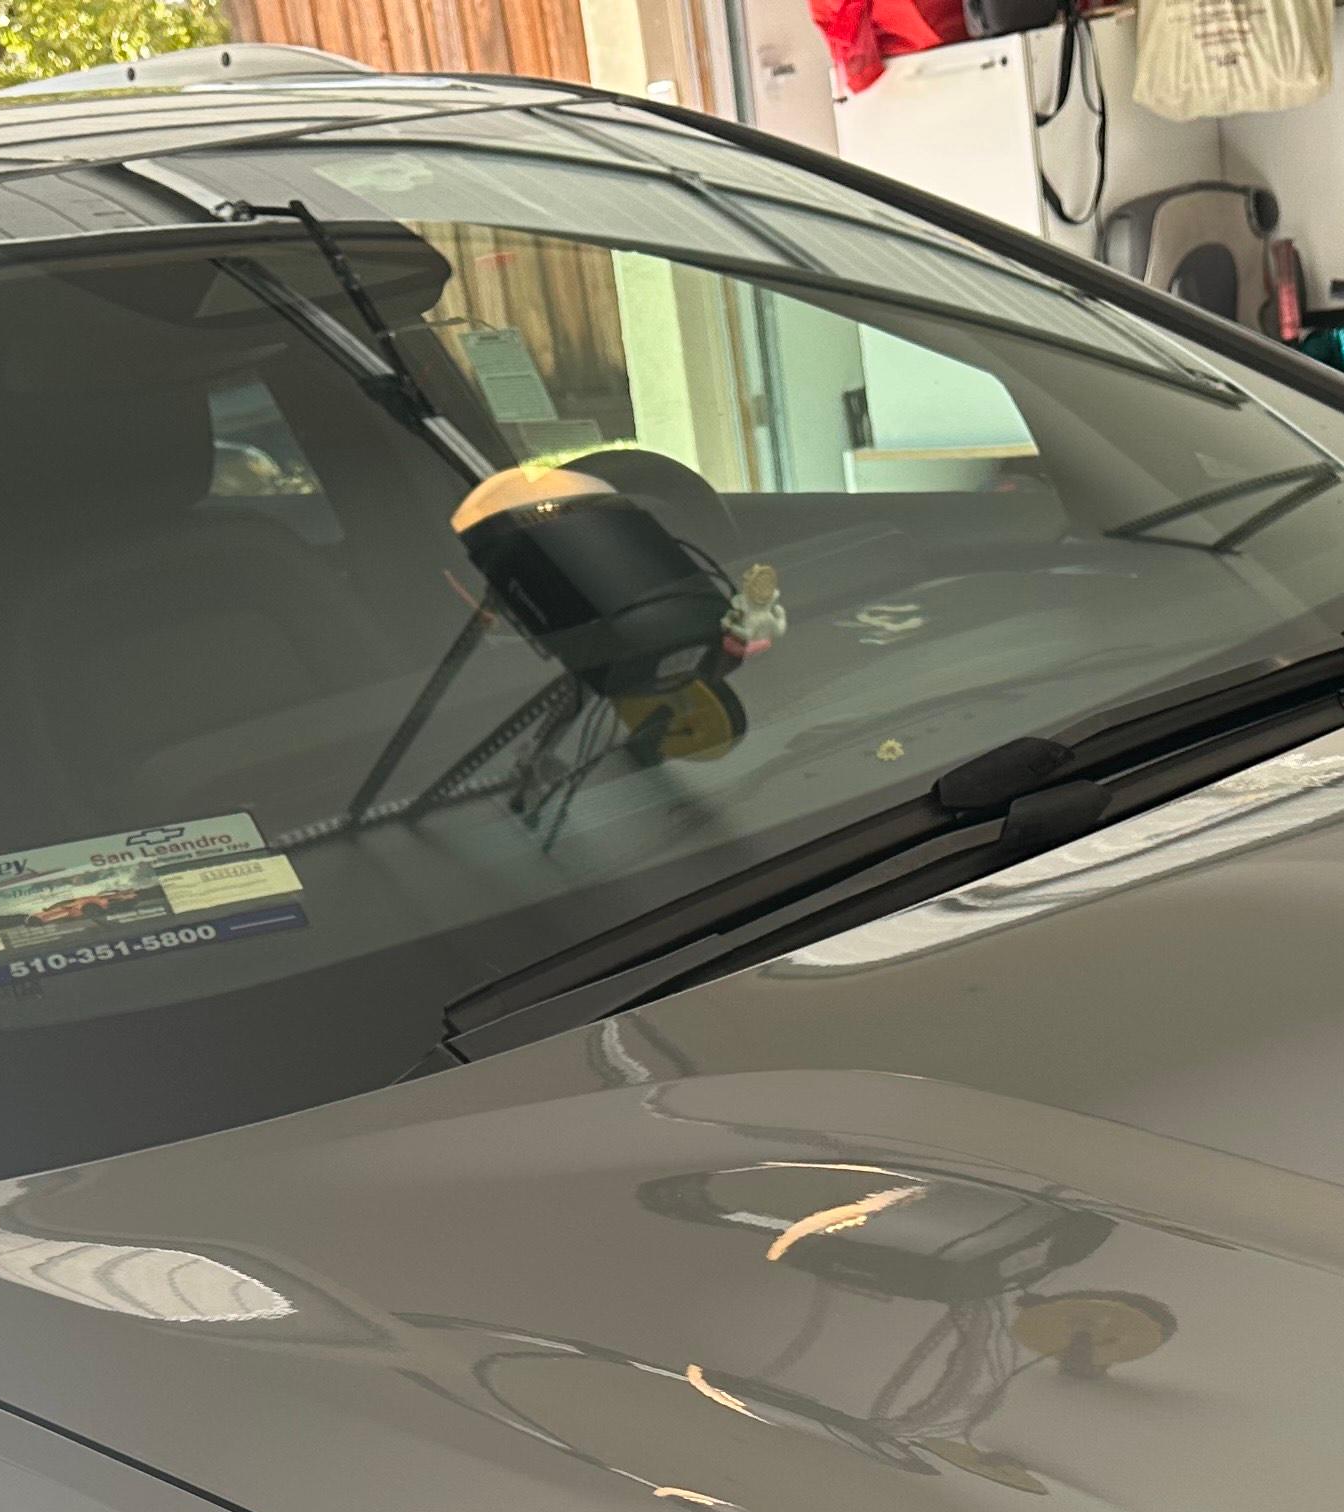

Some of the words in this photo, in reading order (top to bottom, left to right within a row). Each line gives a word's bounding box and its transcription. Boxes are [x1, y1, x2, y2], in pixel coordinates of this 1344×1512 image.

[90, 849, 134, 868] San
[140, 832, 233, 858] Leandro
[9, 924, 217, 978] 510-351-5800
